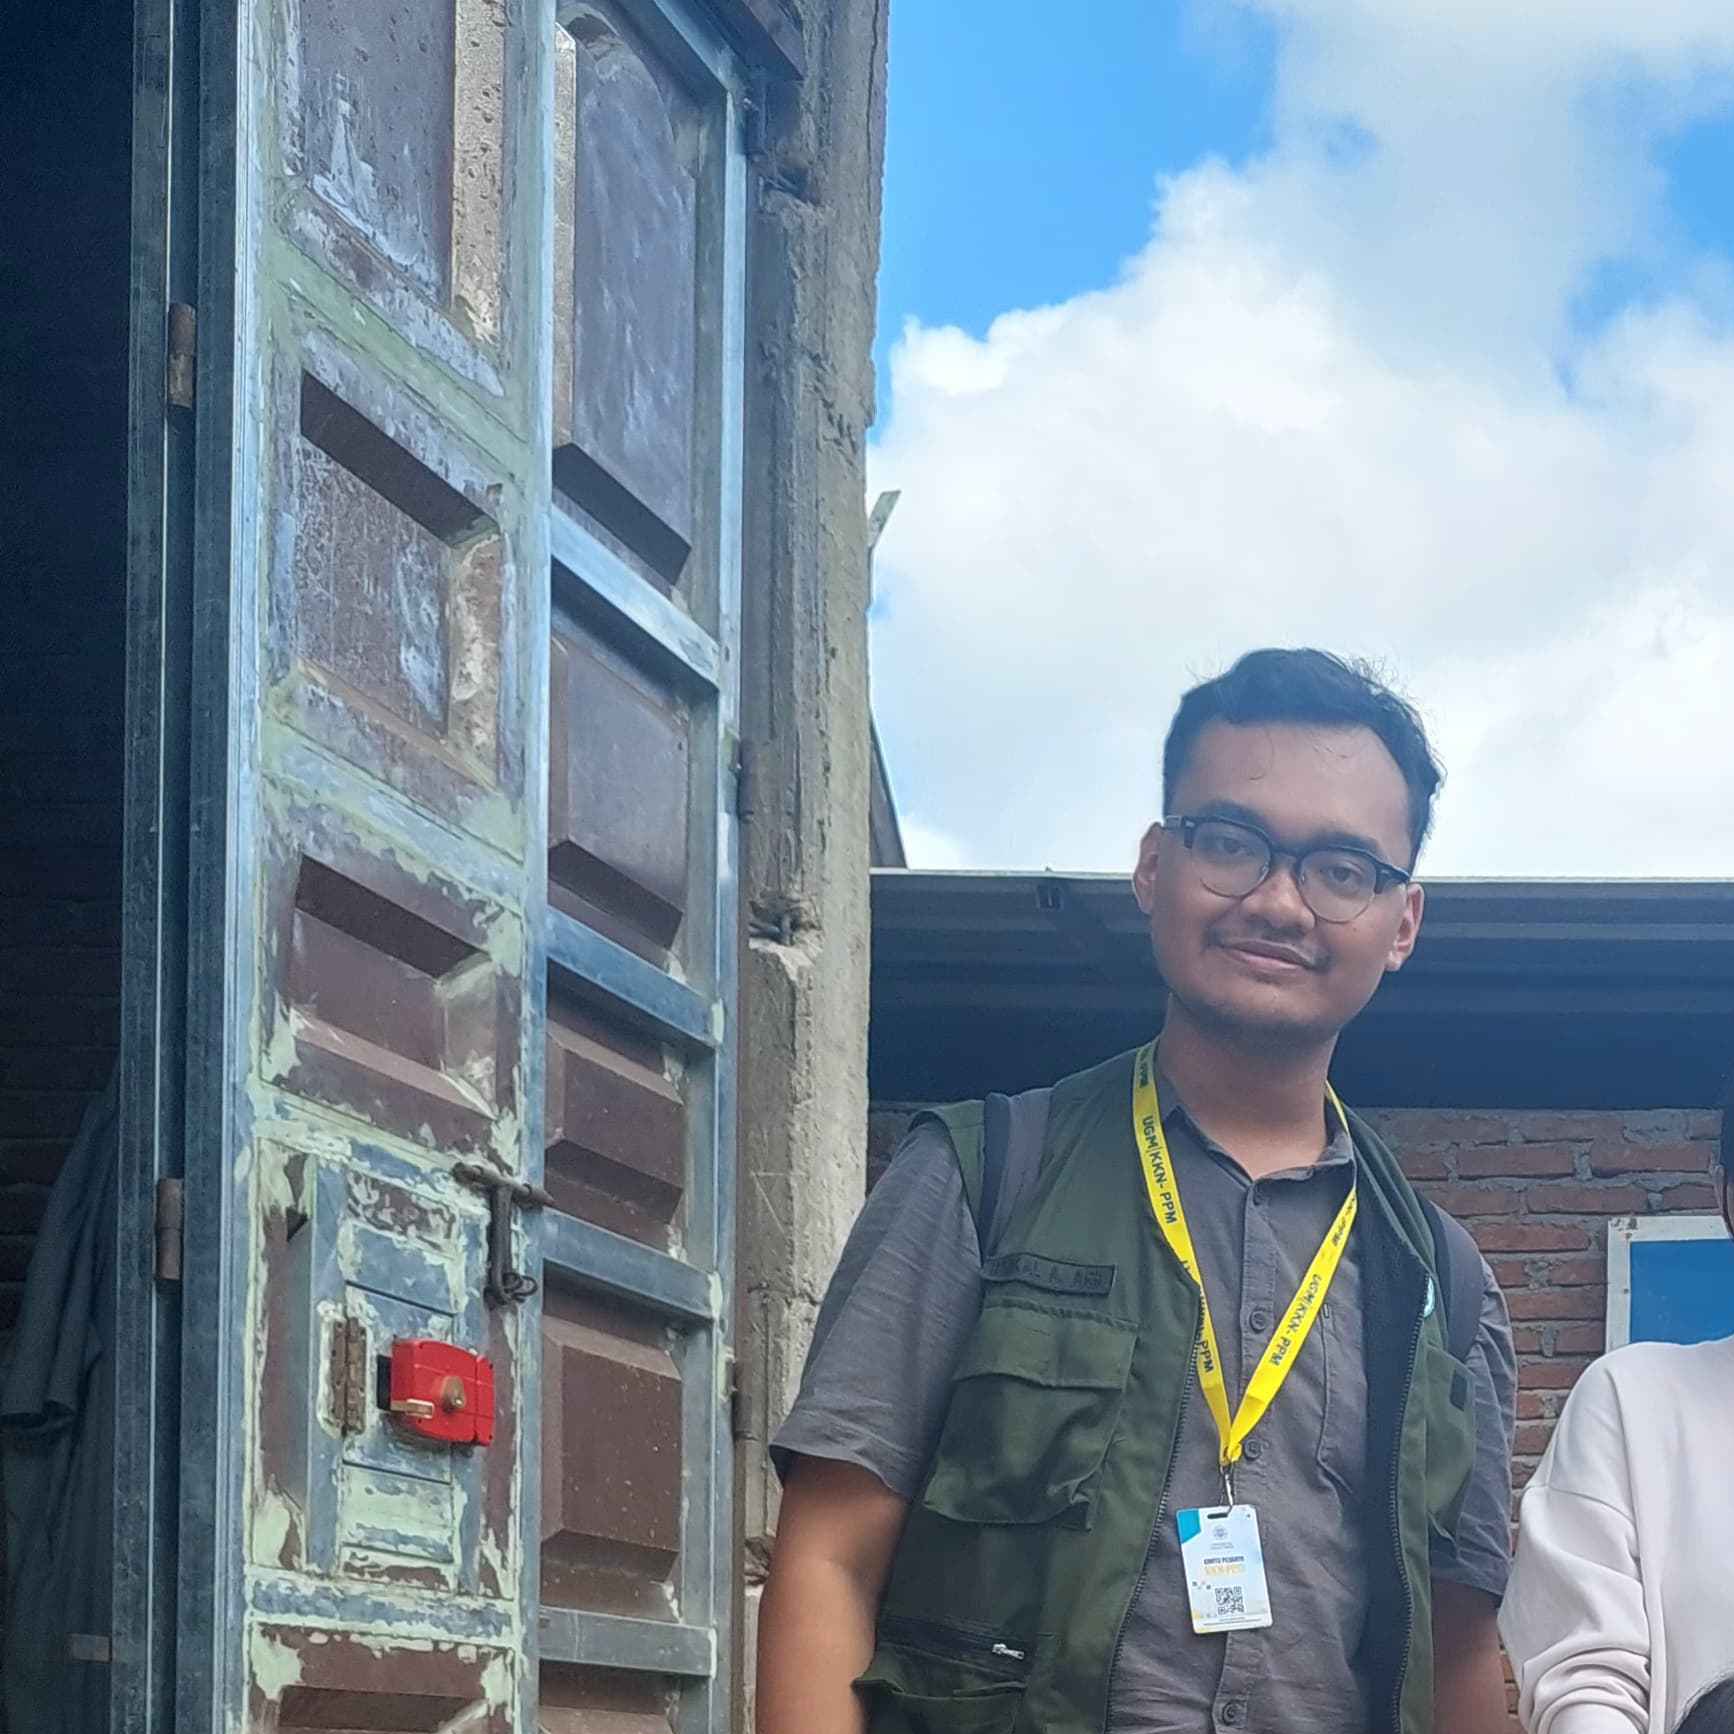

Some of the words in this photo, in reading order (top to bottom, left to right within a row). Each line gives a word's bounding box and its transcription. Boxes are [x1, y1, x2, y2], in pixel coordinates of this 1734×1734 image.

[1161, 1191, 1178, 1225] PPM
[1199, 1340, 1214, 1373] PPM
[1270, 1336, 1291, 1366] PPM
